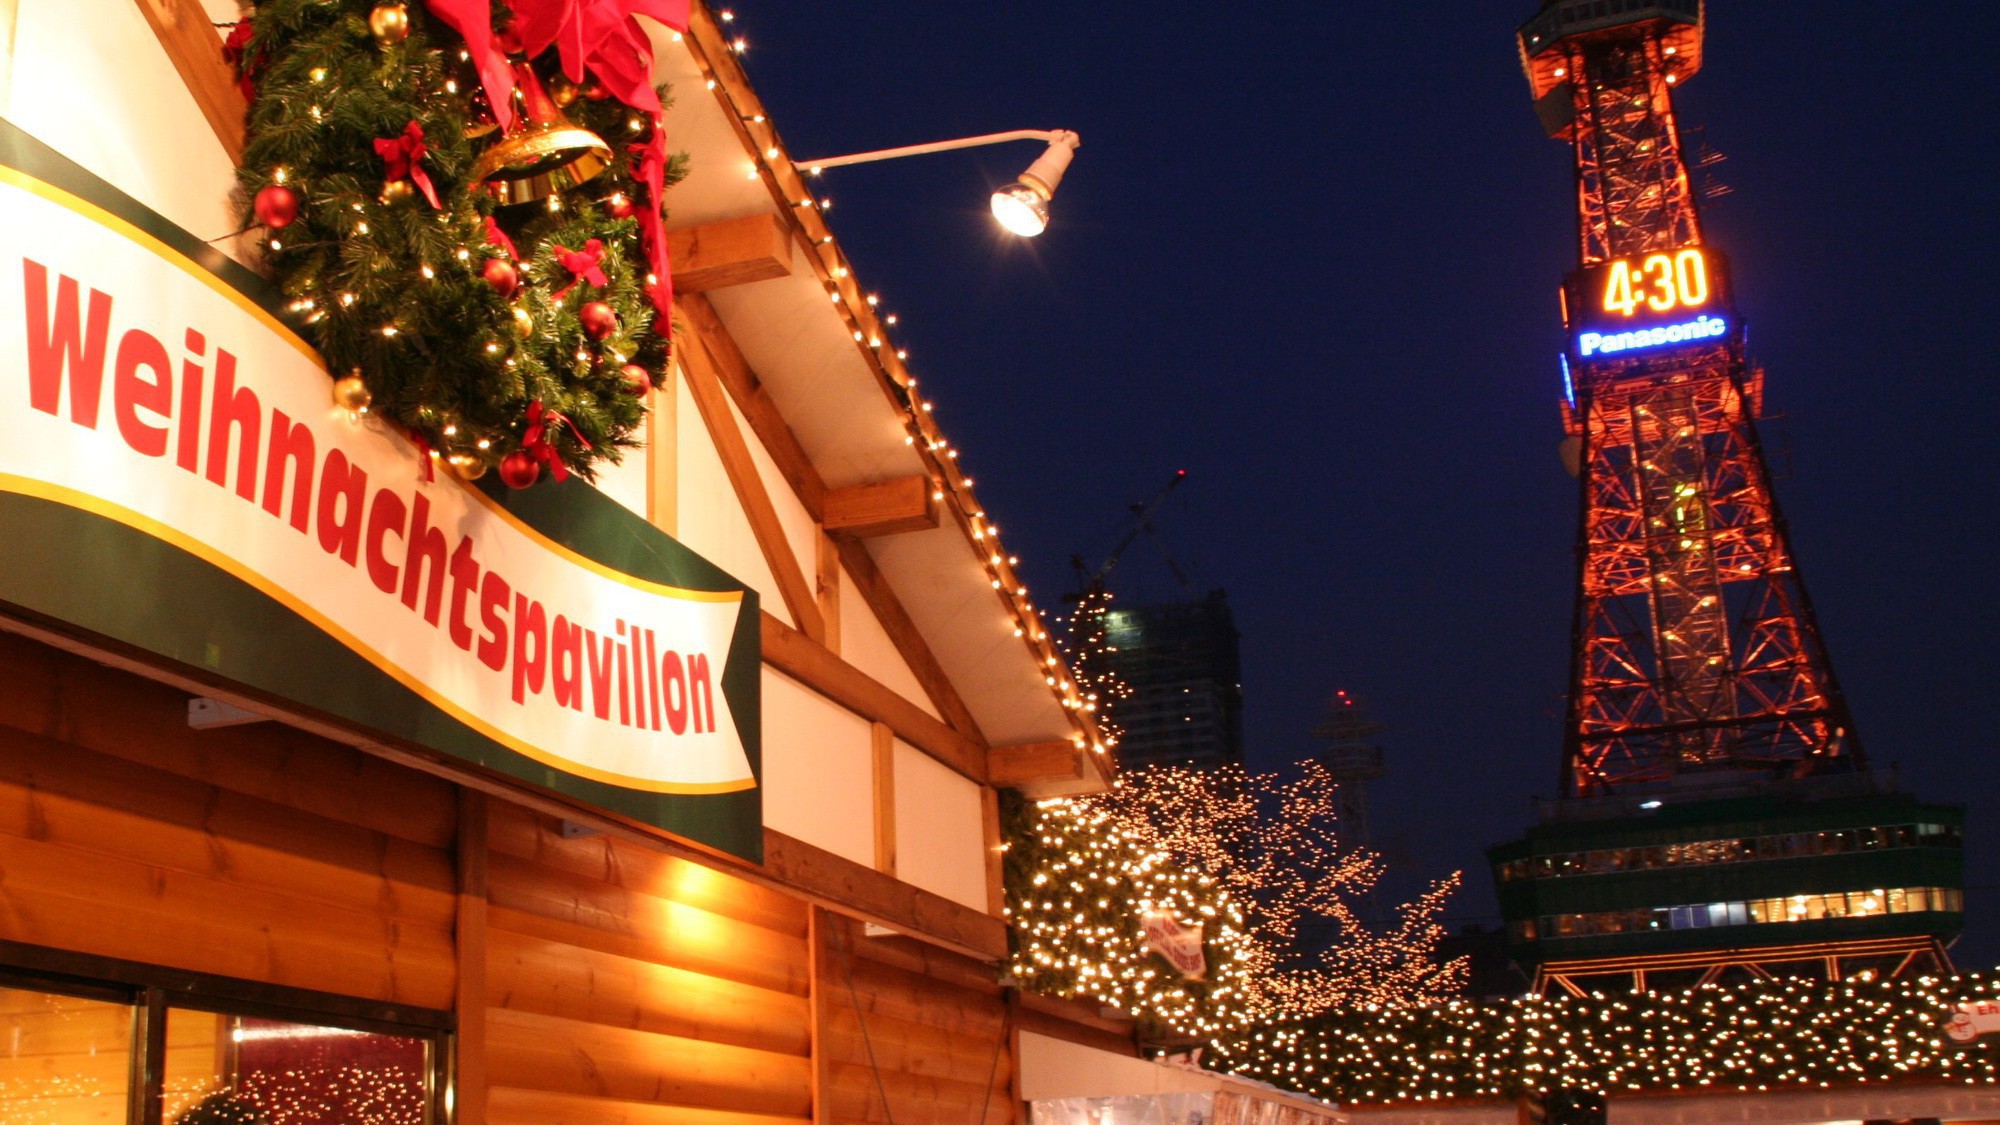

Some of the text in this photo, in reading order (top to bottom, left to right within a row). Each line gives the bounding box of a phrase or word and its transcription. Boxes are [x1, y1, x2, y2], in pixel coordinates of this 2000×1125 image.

[1603, 249, 1708, 316] 4:30
[1580, 315, 1726, 355] Panasonic
[22, 256, 717, 736] Weihnachtspavillon
